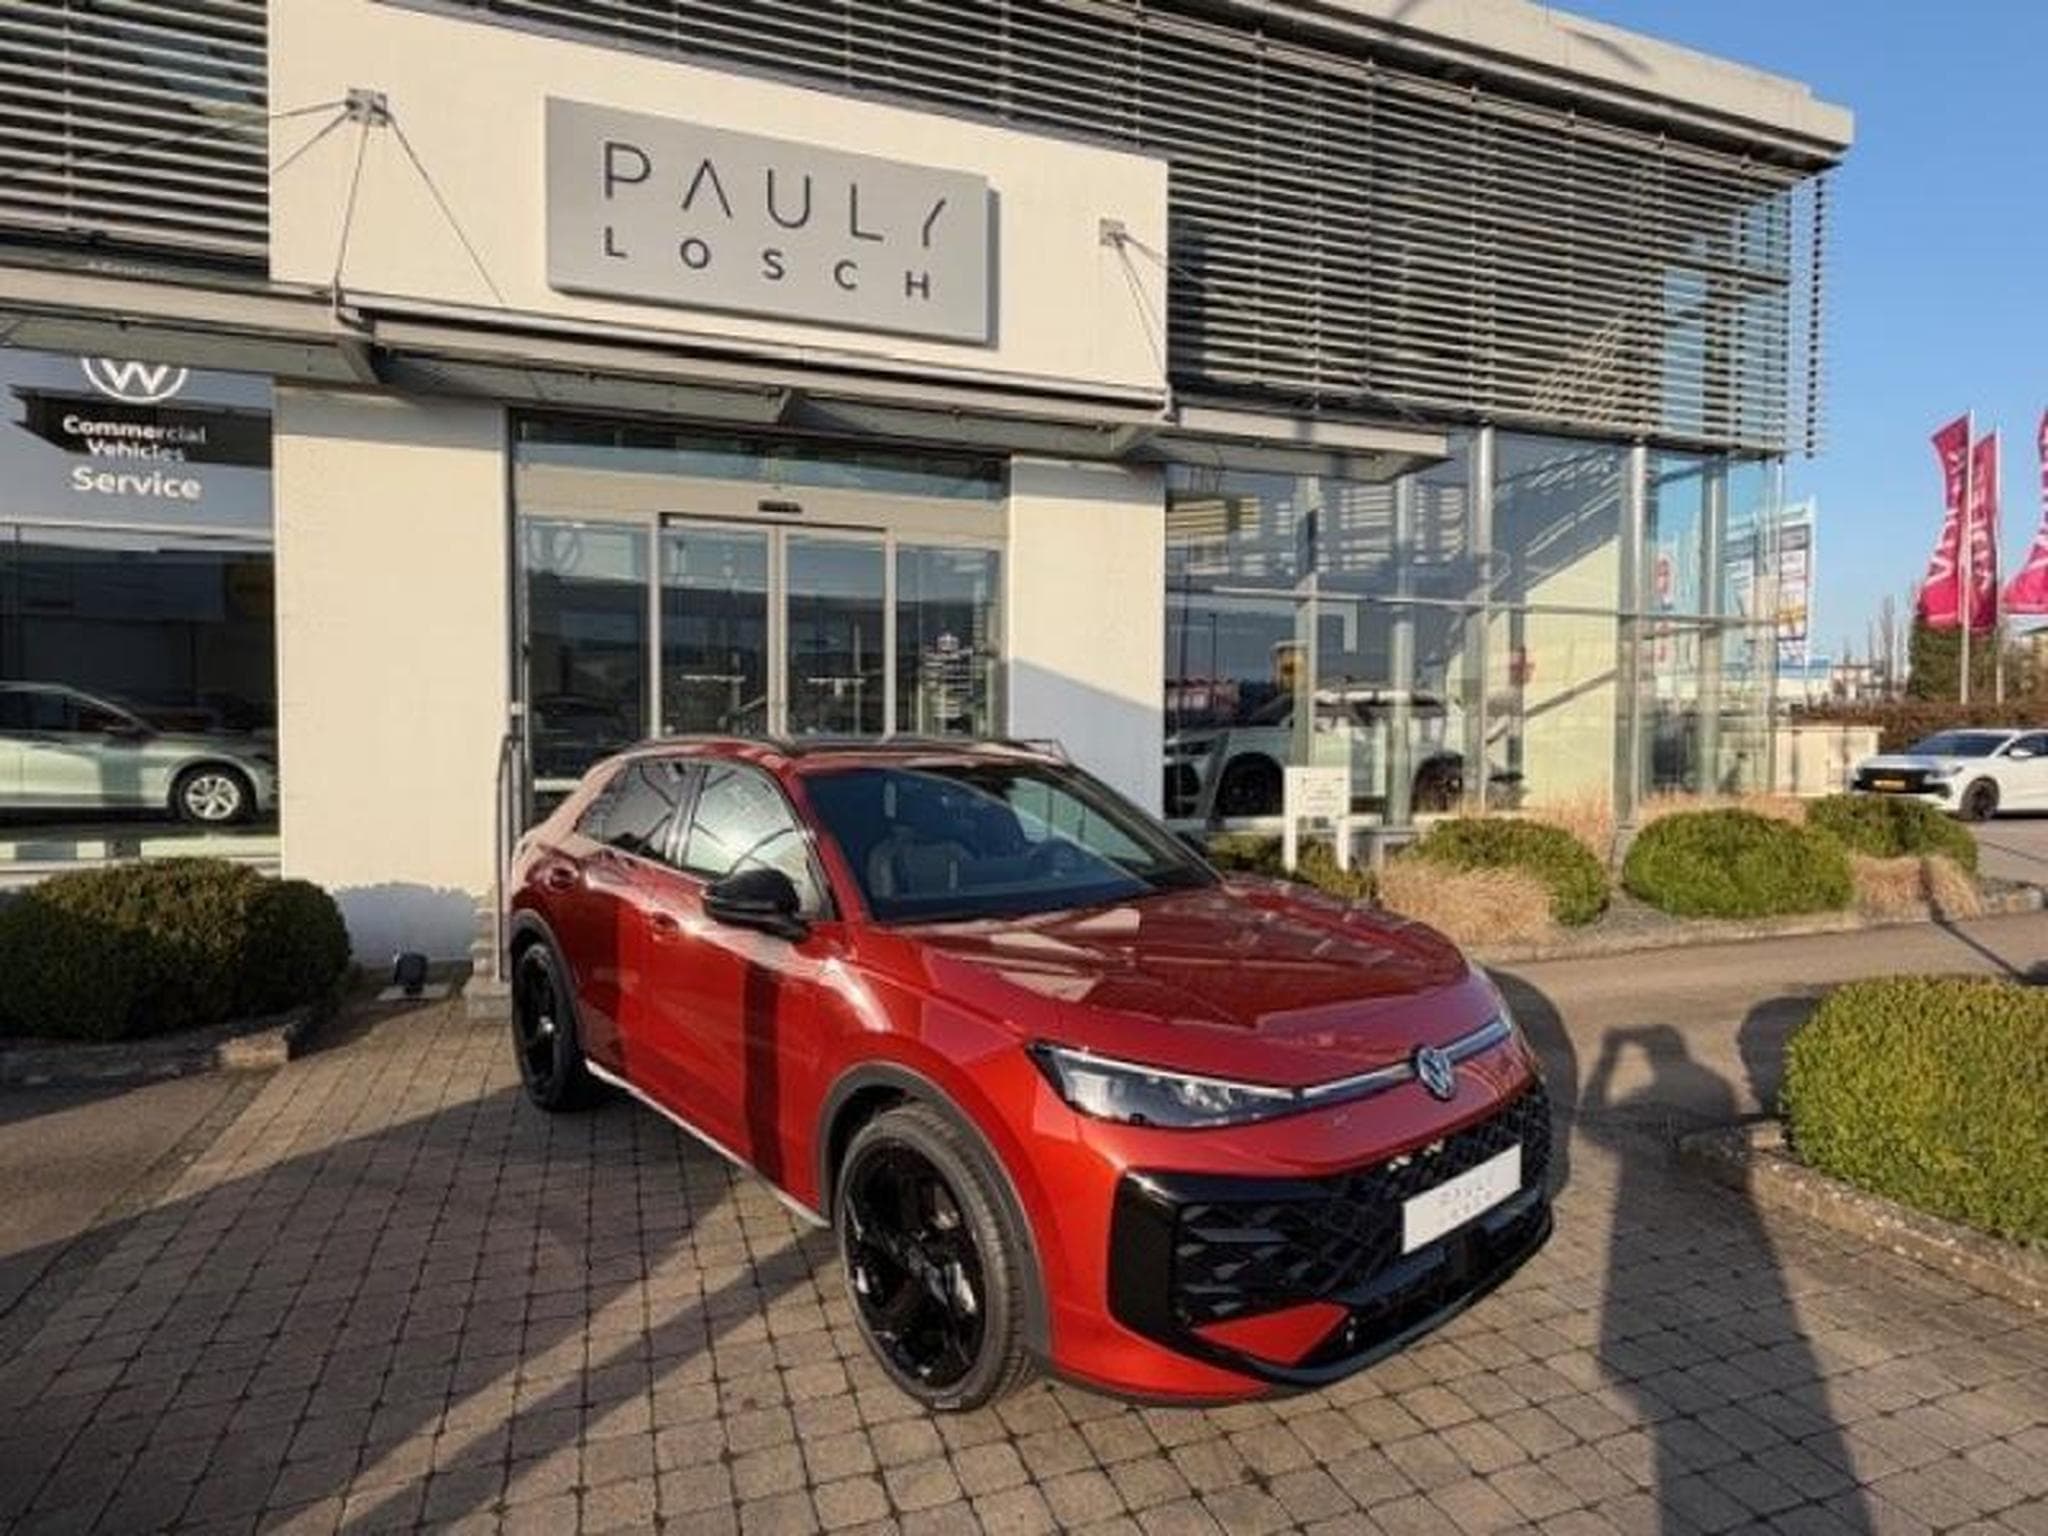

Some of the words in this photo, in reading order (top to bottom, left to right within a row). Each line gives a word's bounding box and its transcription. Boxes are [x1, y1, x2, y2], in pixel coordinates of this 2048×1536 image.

[604, 141, 946, 248] PAULY
[604, 226, 930, 301] LOSCH
[63, 415, 206, 444] Commercial
[87, 439, 186, 462] Vehicles
[71, 465, 203, 499] Service
